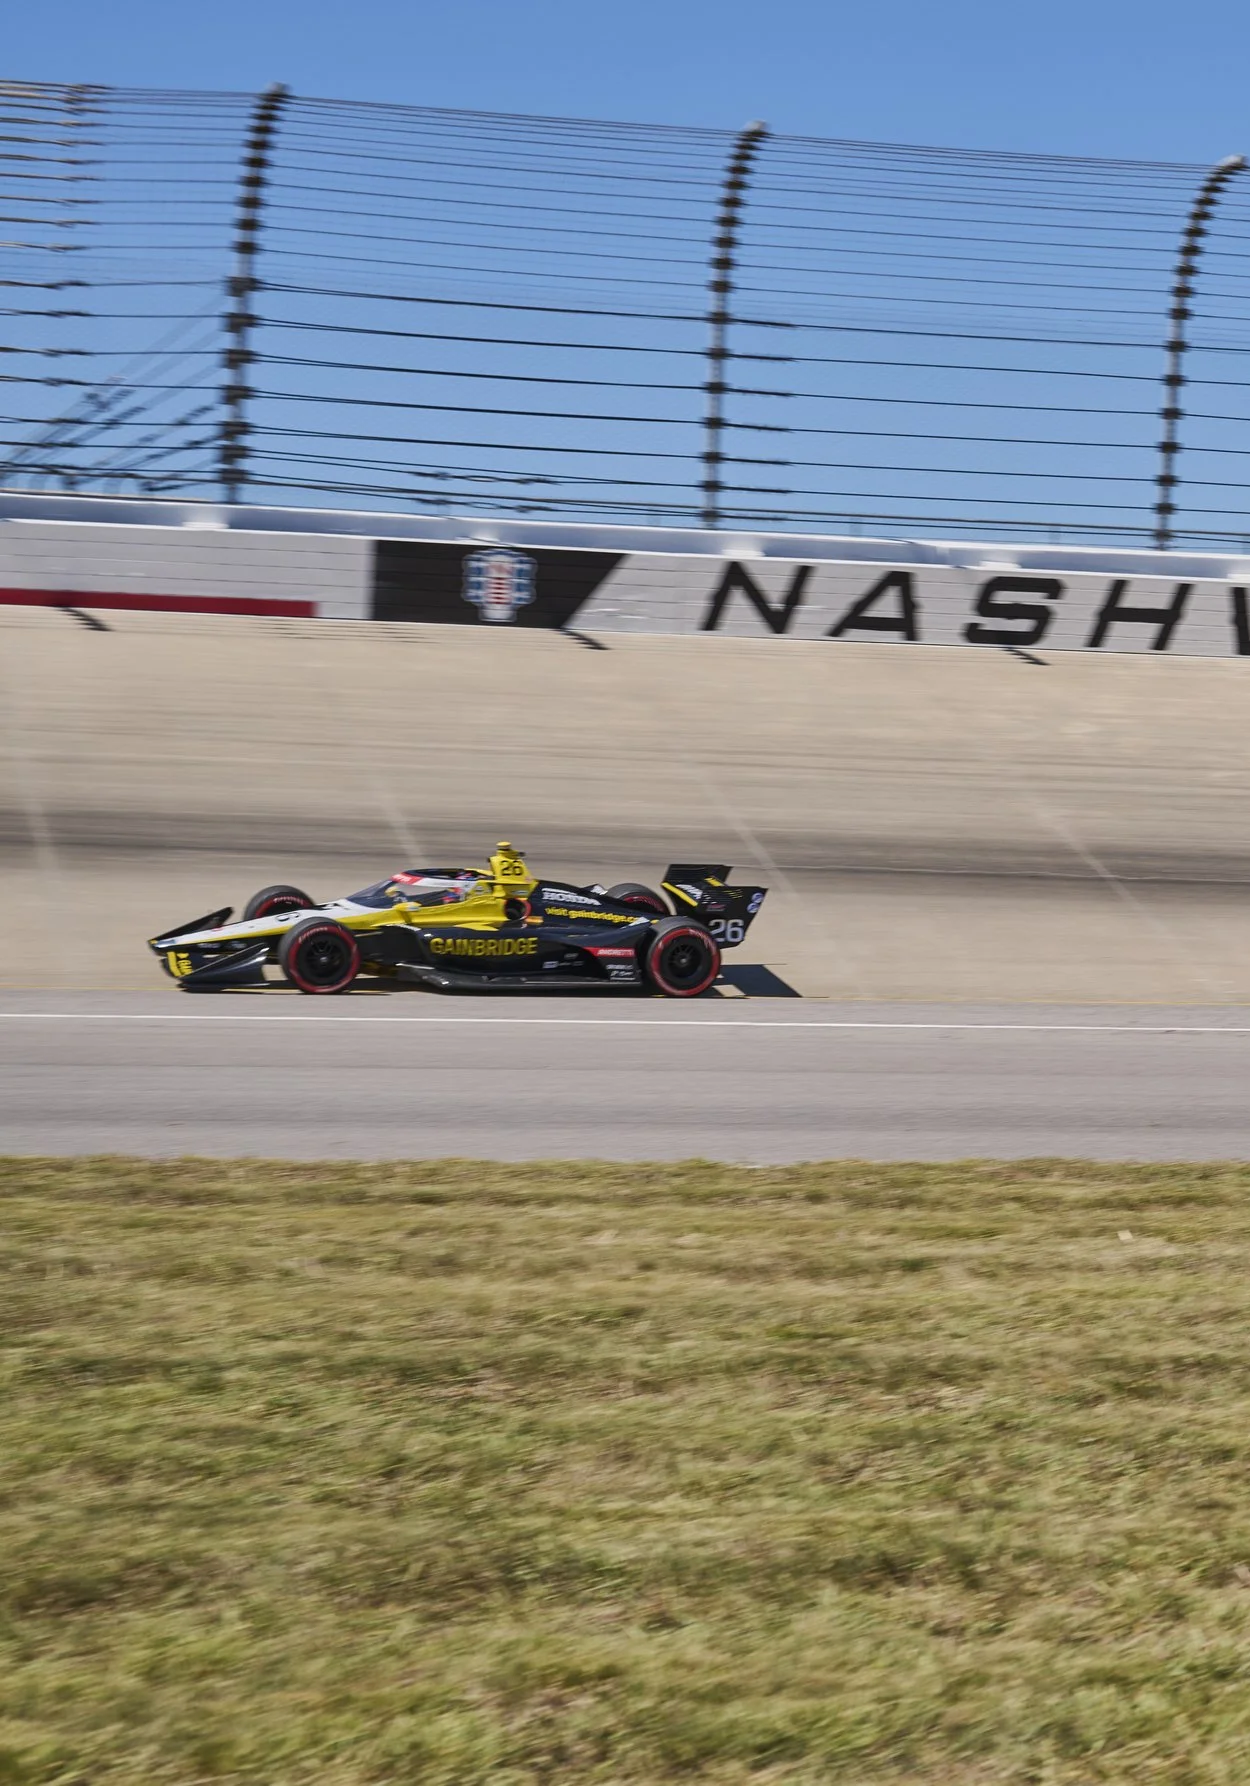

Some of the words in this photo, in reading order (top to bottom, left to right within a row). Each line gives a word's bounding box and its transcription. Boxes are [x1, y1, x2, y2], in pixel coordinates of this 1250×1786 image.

[499, 859, 524, 877] 26
[708, 918, 744, 943] 26
[429, 937, 538, 957] GAINBRIDGE
